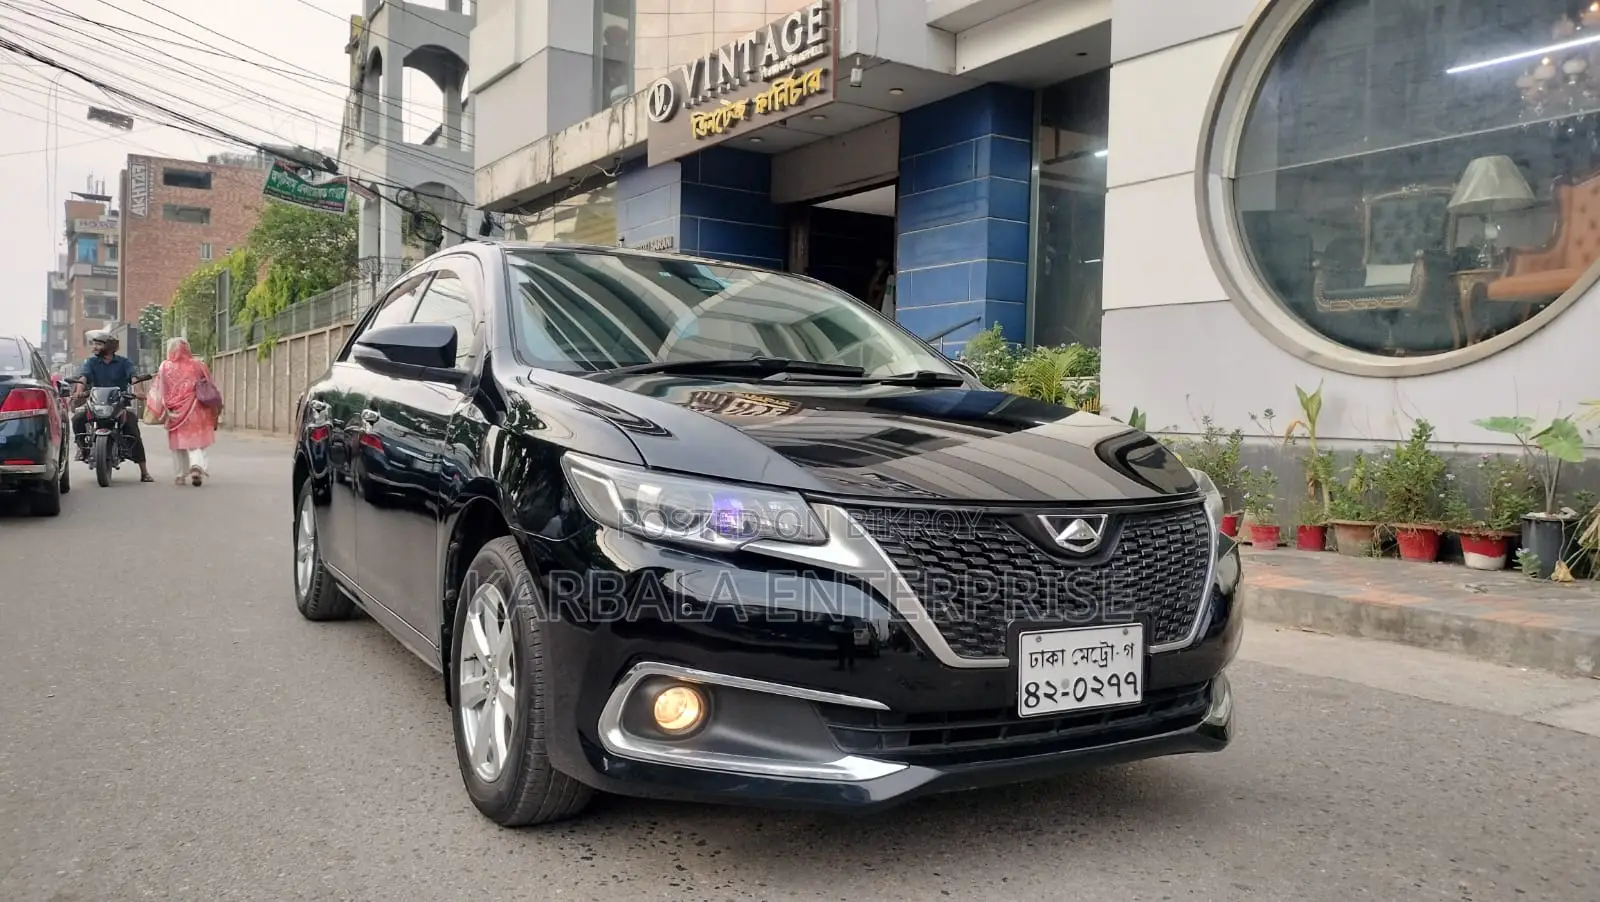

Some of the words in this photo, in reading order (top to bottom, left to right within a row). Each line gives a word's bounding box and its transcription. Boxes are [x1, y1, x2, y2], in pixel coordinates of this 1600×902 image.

[681, 0, 827, 97] VINTAGE
[1028, 648, 1066, 669] ঢাকা
[1023, 671, 1139, 709] ৪২-০২৭৭
